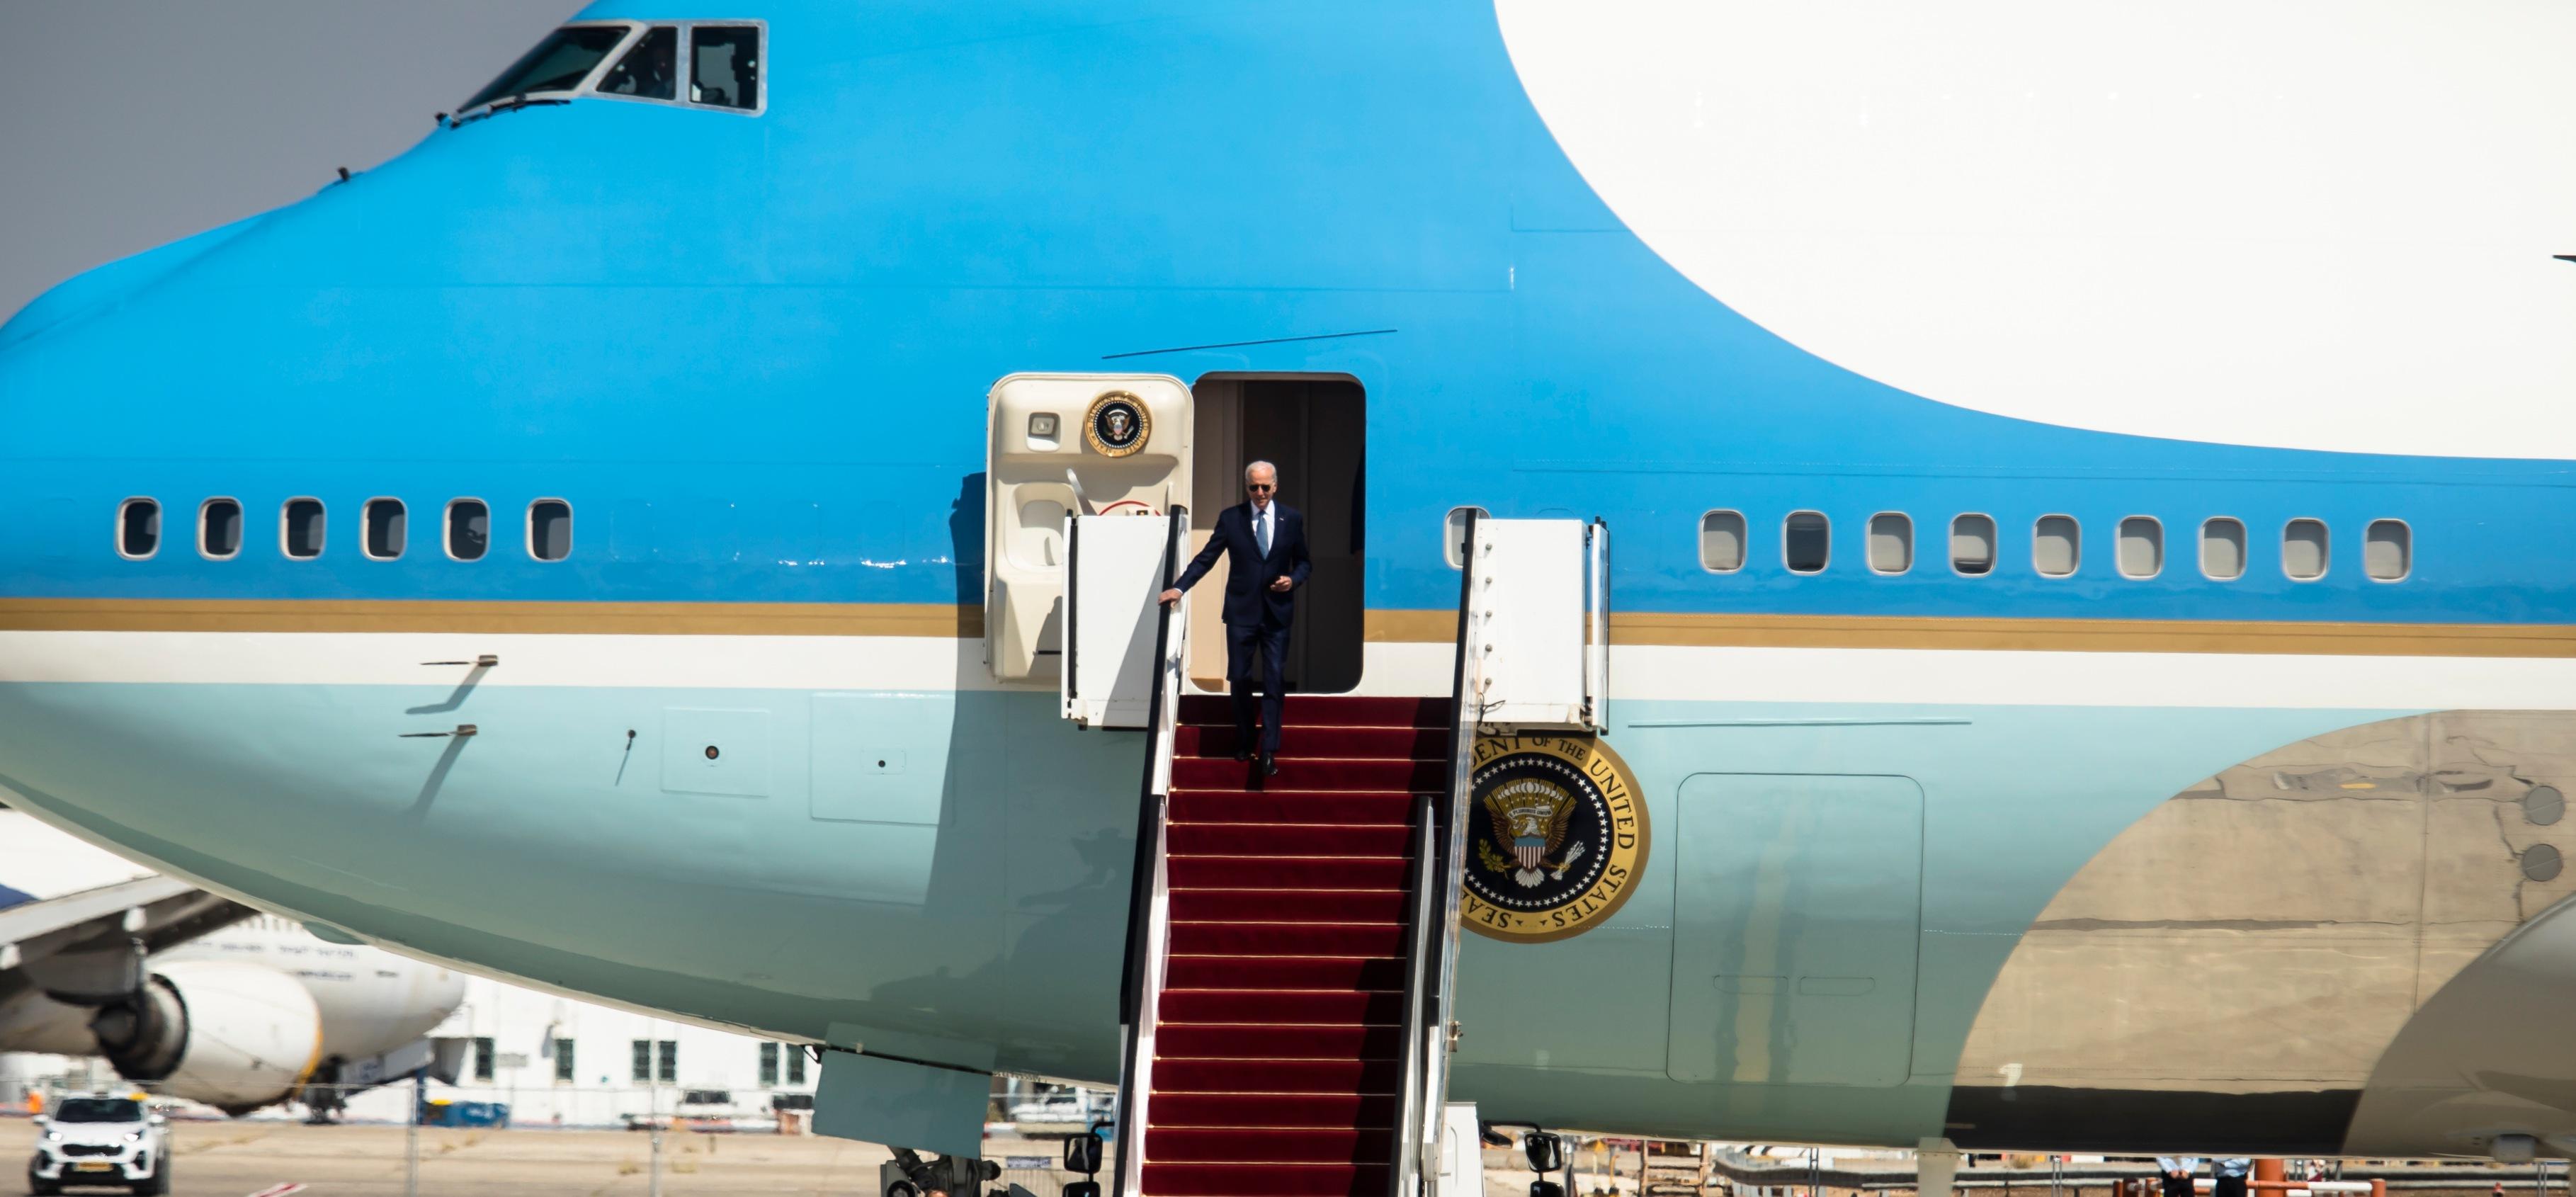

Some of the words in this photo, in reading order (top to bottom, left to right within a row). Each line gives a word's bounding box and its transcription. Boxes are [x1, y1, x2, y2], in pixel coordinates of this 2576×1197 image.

[1532, 737, 1553, 747] OF
[1559, 739, 1586, 761] THE
[1590, 758, 1635, 849] UNITED
[1552, 864, 1627, 927] STATES
